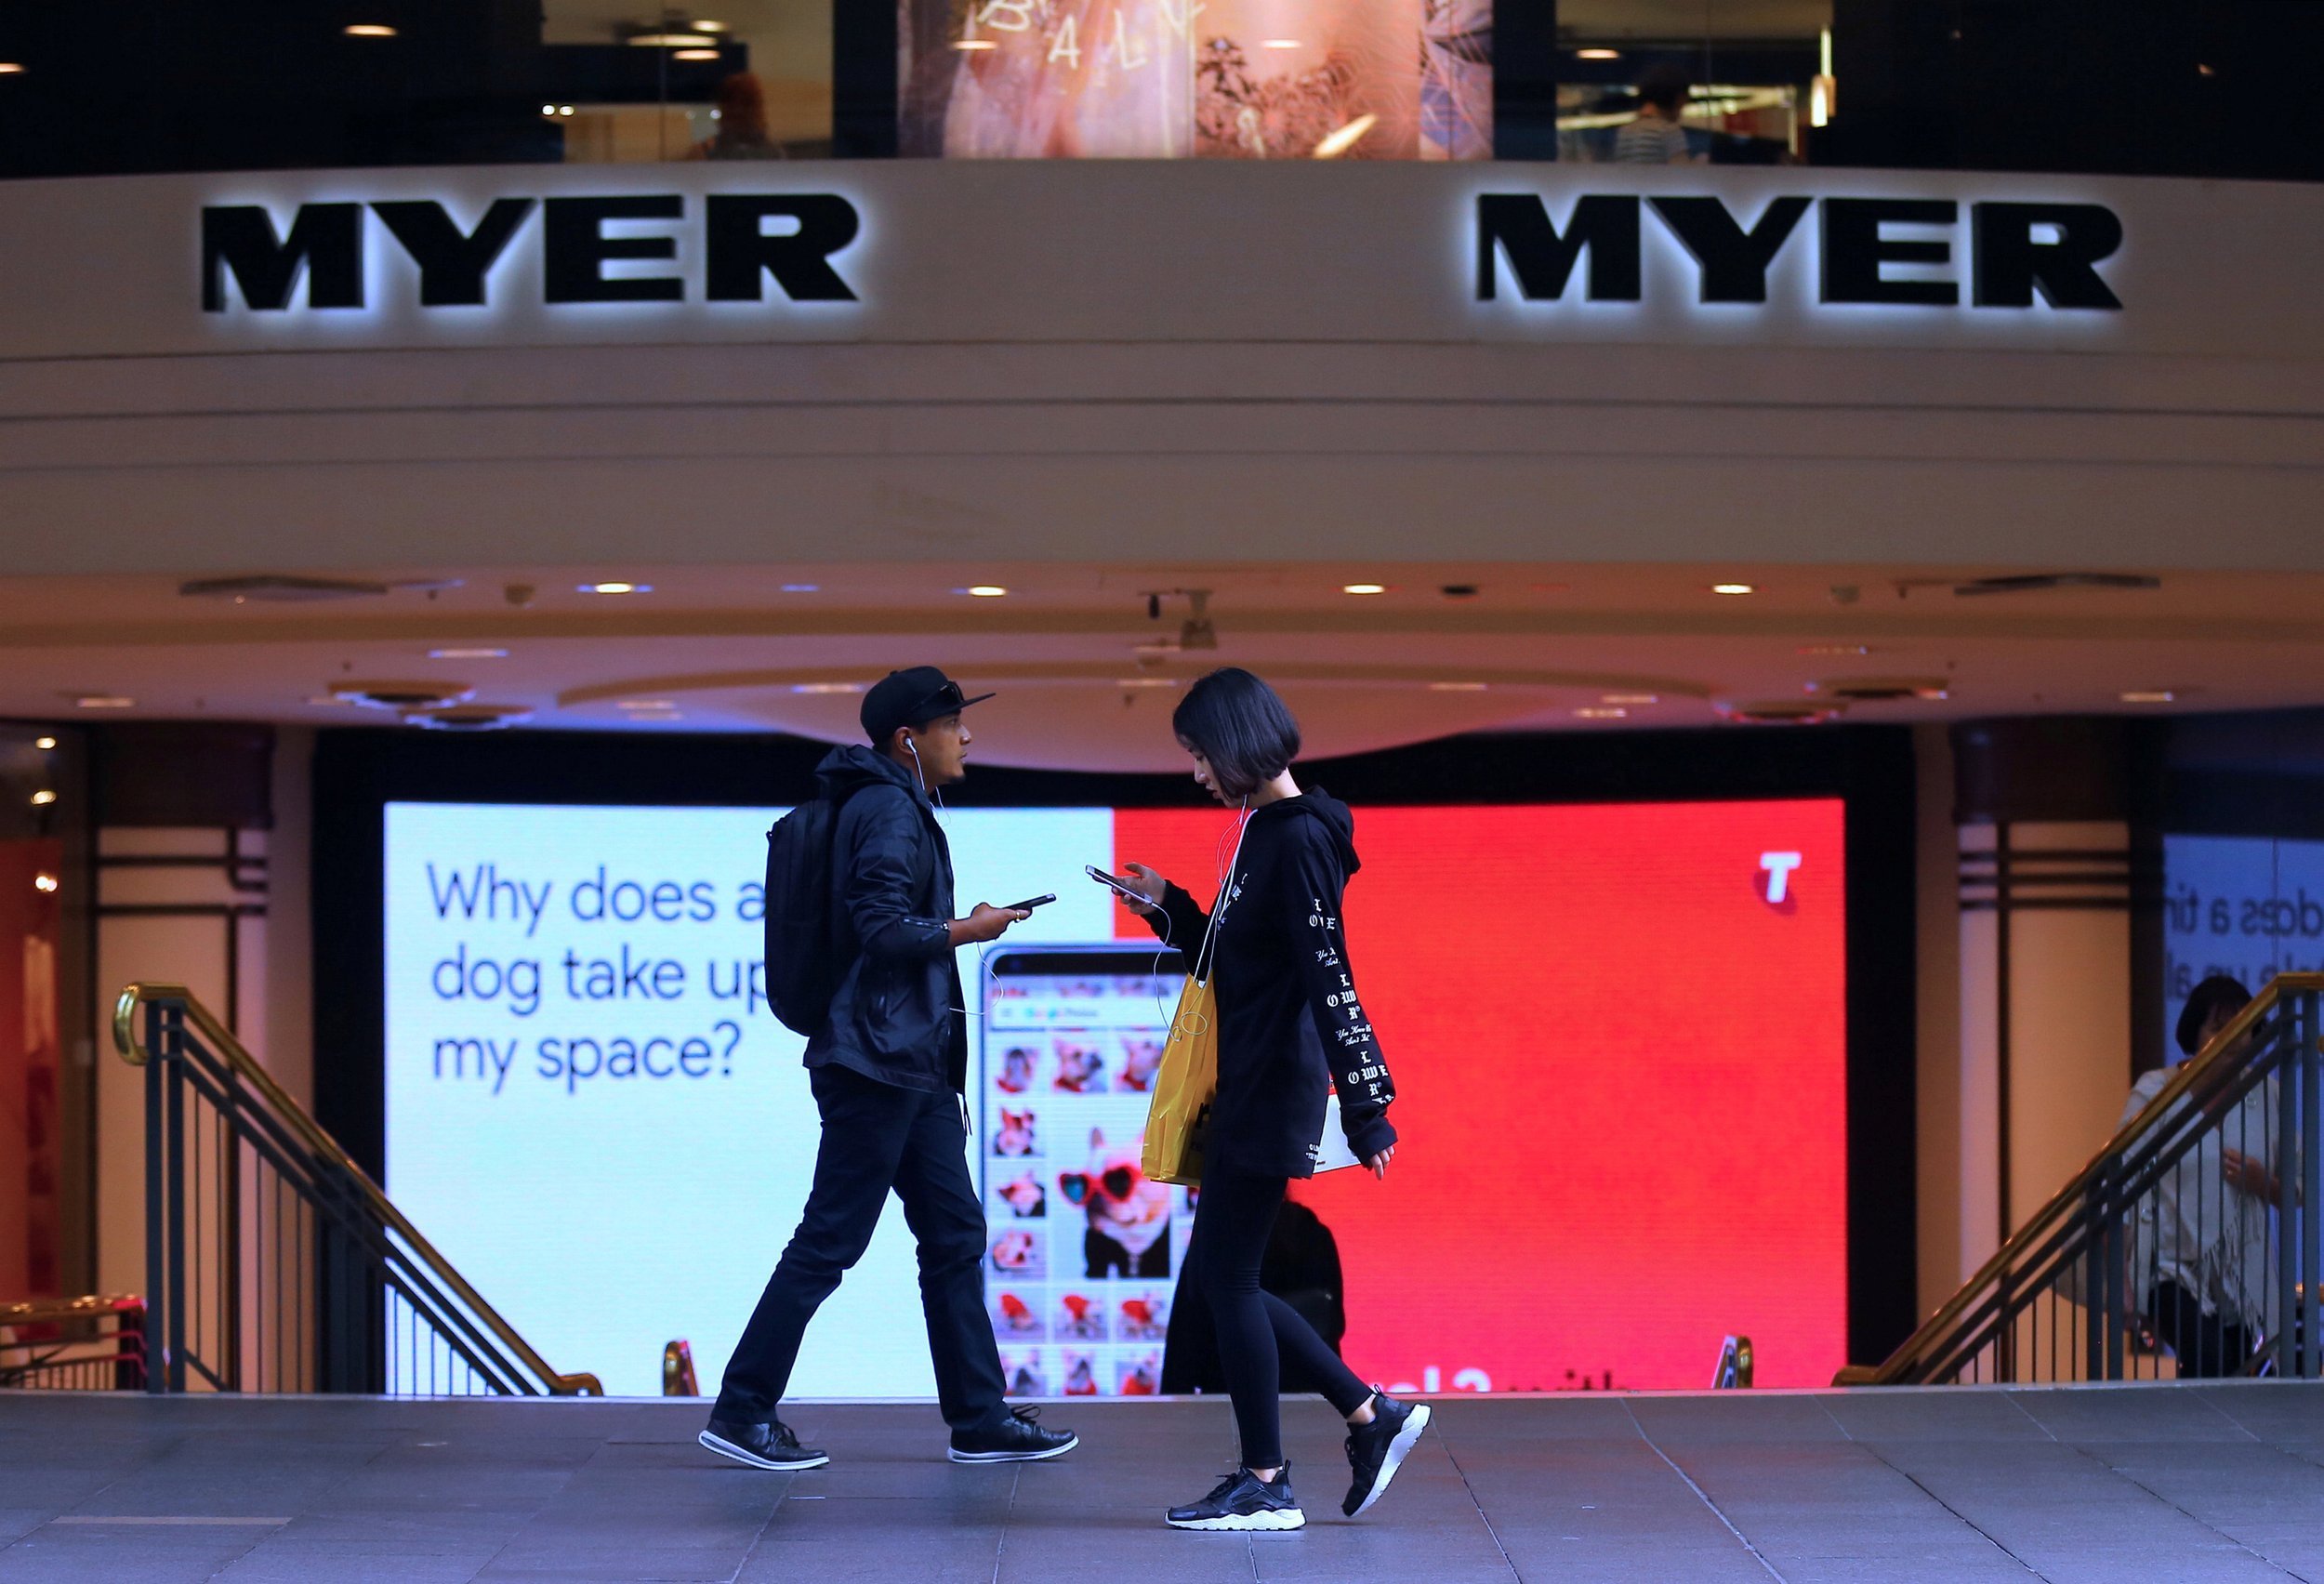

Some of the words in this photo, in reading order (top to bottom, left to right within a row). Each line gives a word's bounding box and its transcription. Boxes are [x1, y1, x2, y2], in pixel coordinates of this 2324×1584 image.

[202, 194, 861, 312] MYER
[1476, 193, 2124, 310] MYER
[427, 863, 552, 937] Why
[570, 864, 717, 922] does
[736, 881, 766, 921] a
[432, 942, 541, 1016] dog
[561, 943, 685, 1000] take
[434, 1038, 518, 1096] my
[536, 1020, 742, 1095] space?
